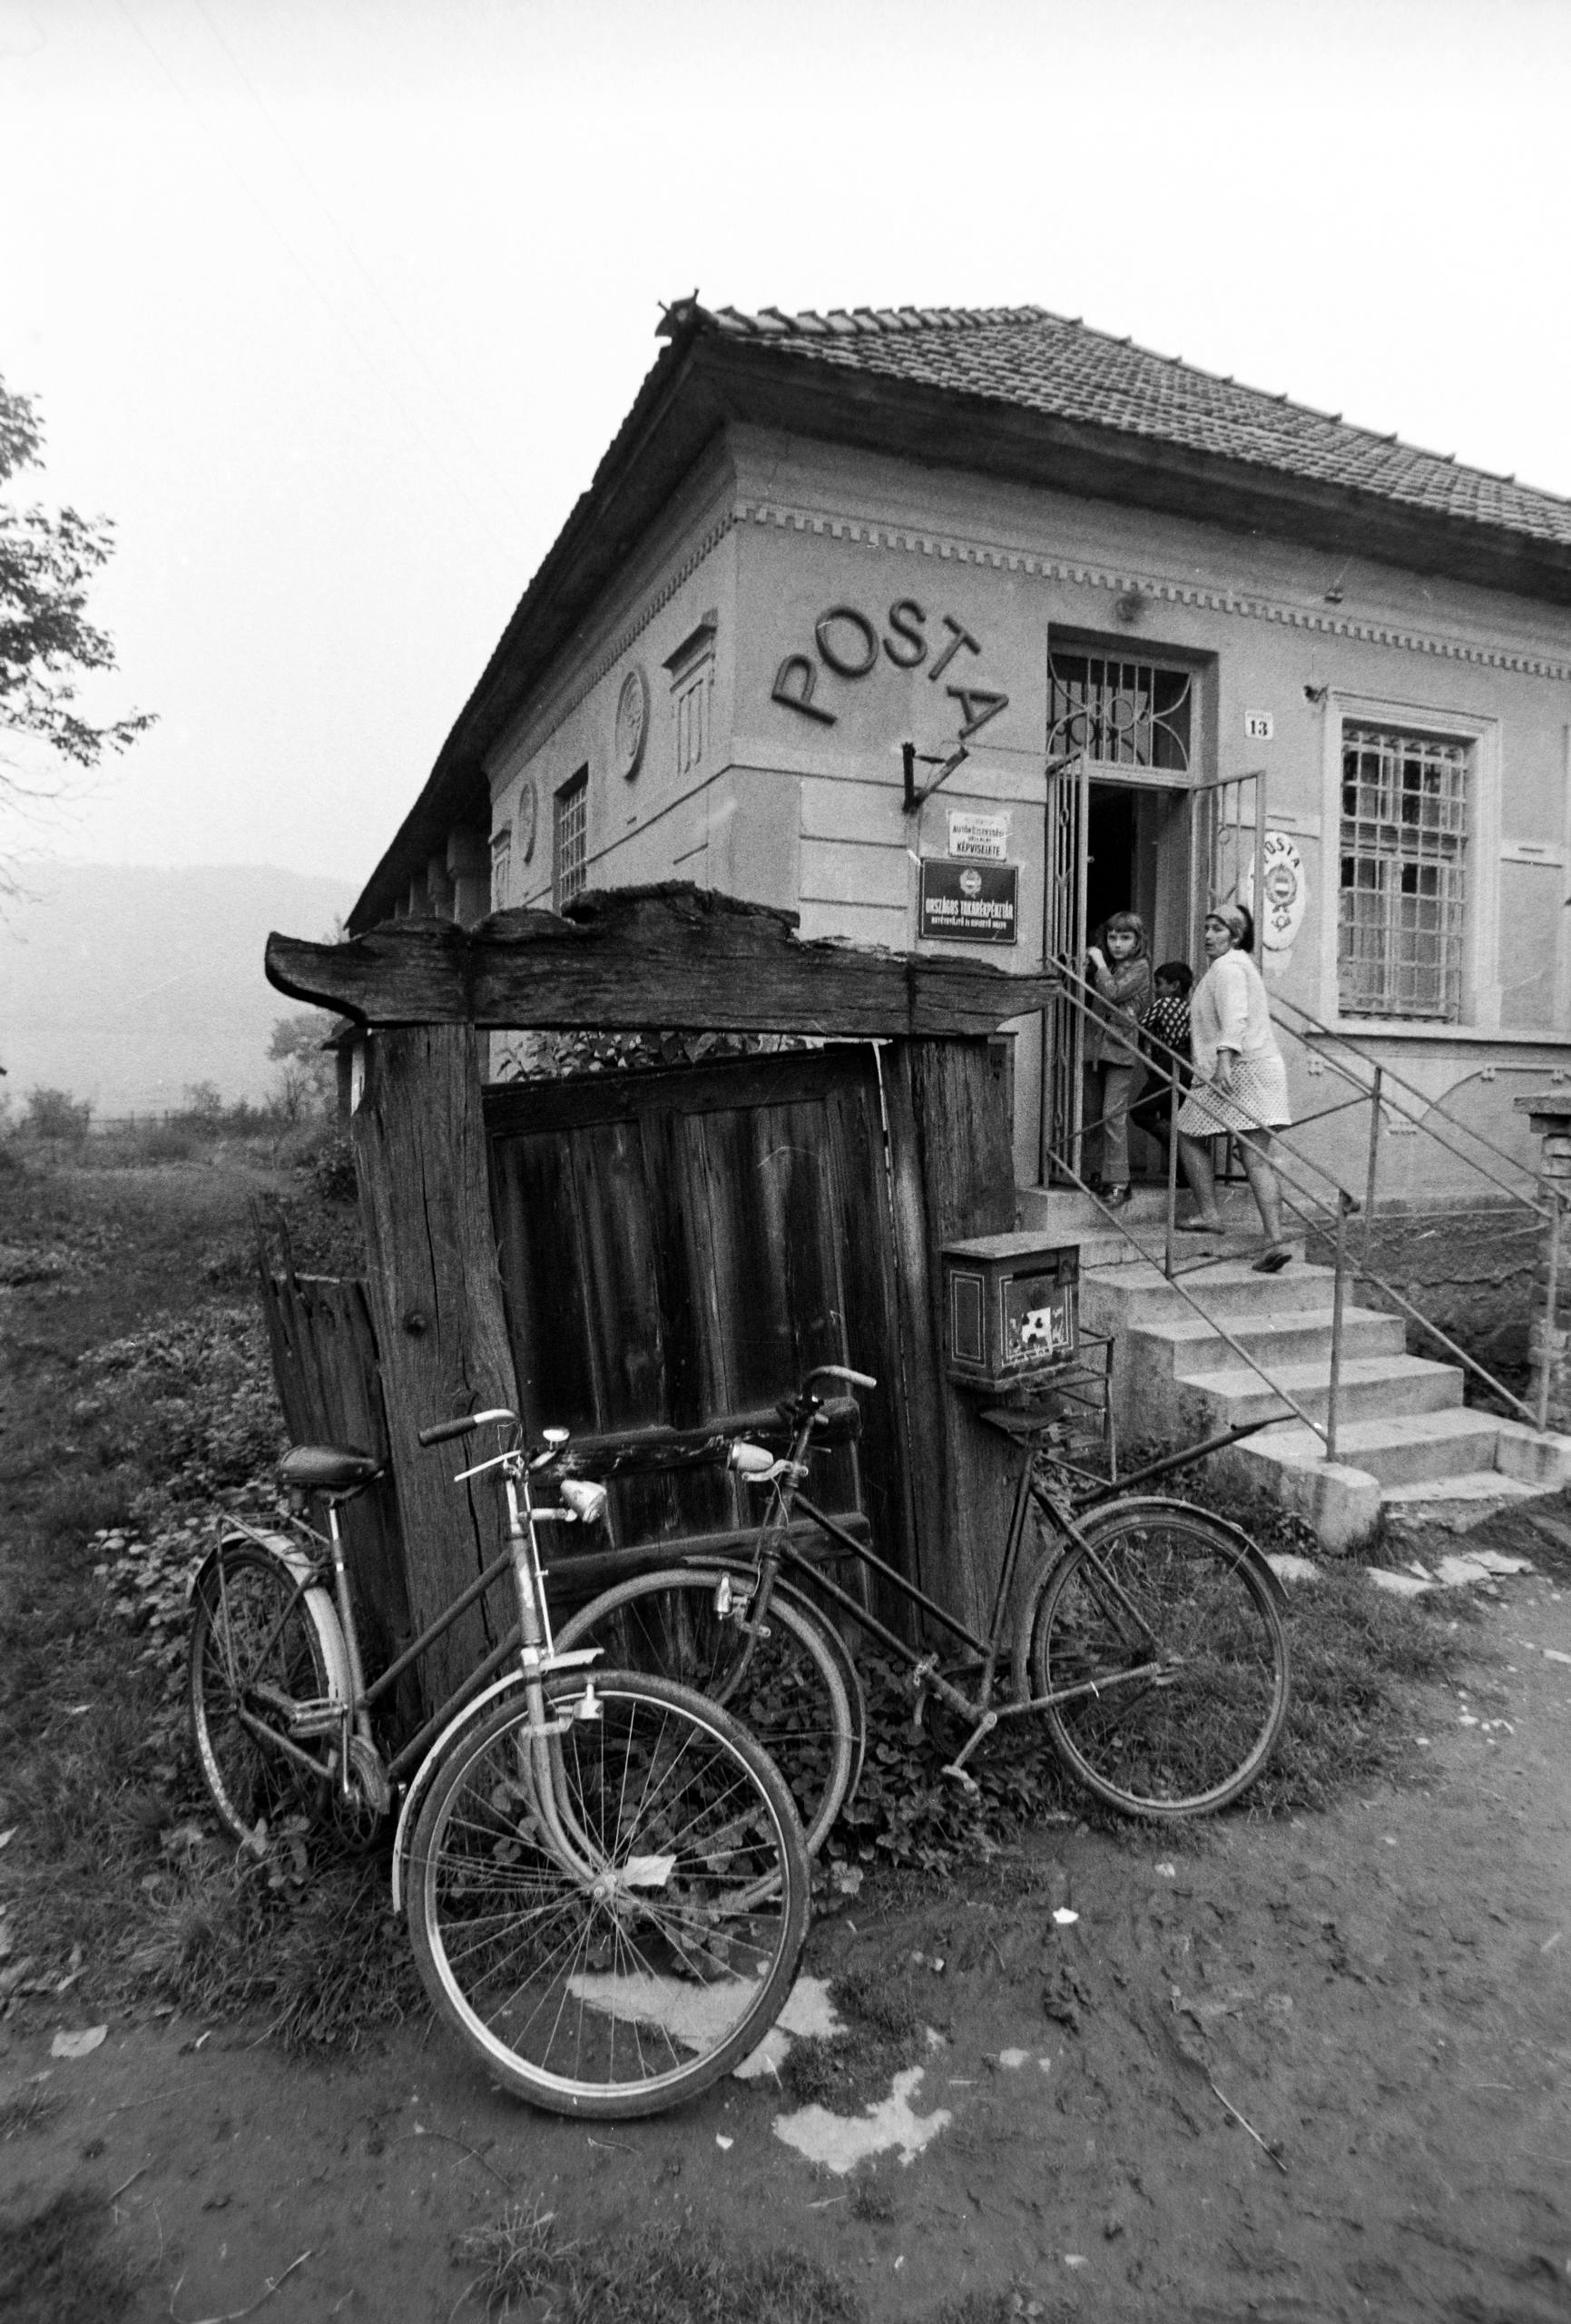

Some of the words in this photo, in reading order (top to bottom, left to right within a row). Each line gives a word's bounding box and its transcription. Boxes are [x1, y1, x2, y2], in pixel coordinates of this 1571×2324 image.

[771, 596, 1009, 741] POSTA
[1251, 719, 1268, 736] 13
[957, 840, 1001, 856] KÉPVISELETE
[926, 895, 959, 915] ORSZÁGOS
[960, 898, 1014, 920] TAKARÉKPÉNZTÁR
